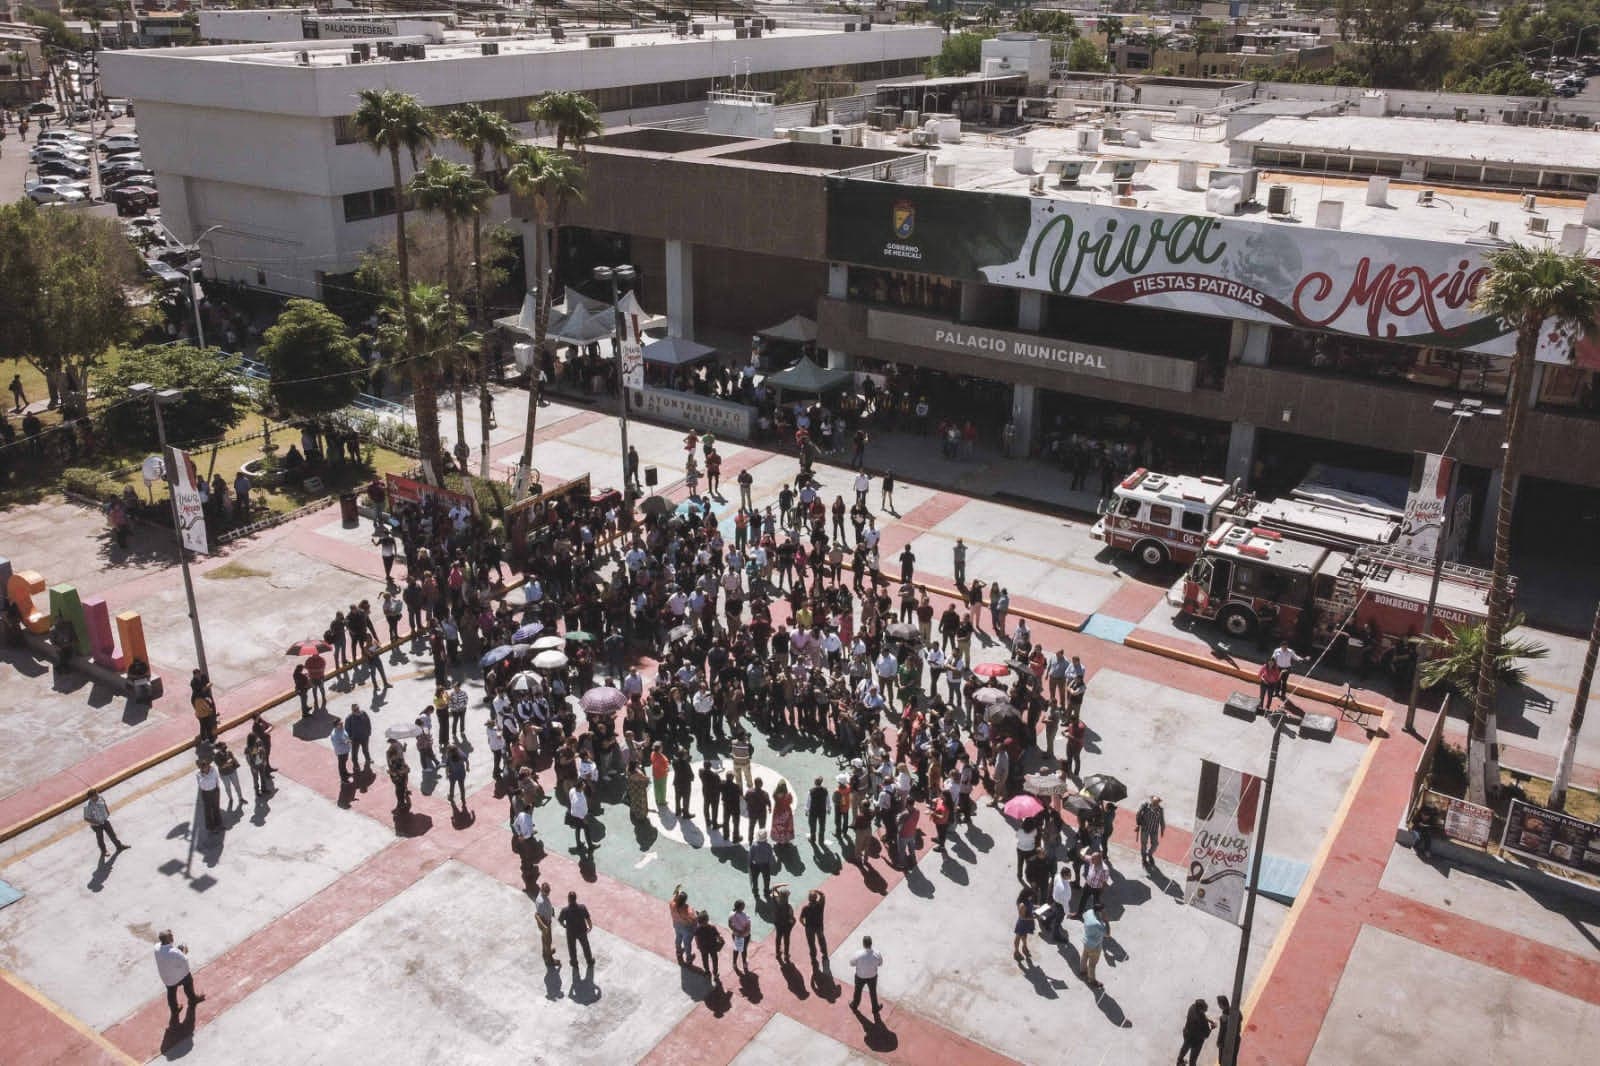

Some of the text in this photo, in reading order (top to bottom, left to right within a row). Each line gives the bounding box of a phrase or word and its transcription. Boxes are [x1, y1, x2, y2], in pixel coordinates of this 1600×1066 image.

[324, 23, 393, 35] PALACIO FEDERAL
[886, 243, 919, 253] GOBIERNO
[1029, 214, 1227, 294] Viva
[1132, 275, 1265, 306] FIESTAS PATRIAS
[935, 329, 1107, 369] PALACIO MUNICIPAL
[1375, 594, 1419, 612] BOMBEROS
[1195, 830, 1247, 849] Viva
